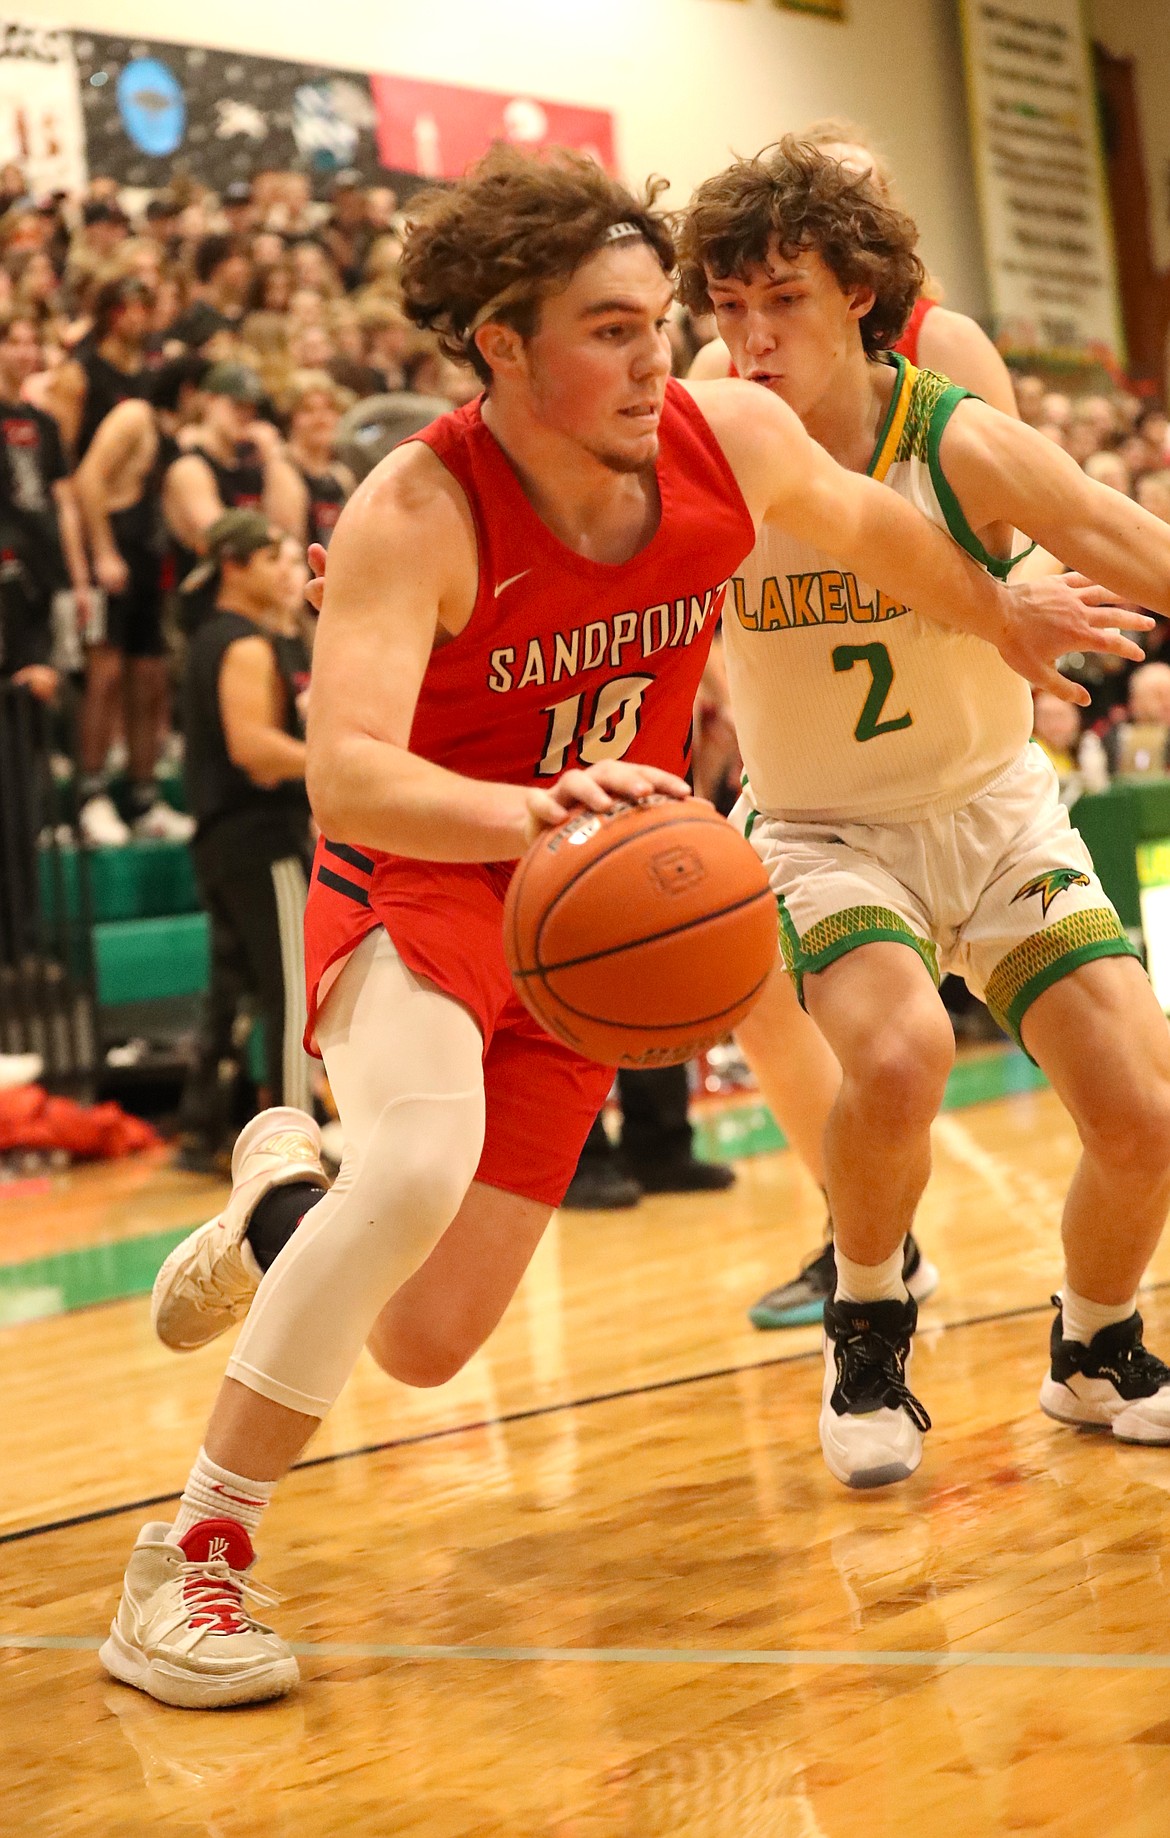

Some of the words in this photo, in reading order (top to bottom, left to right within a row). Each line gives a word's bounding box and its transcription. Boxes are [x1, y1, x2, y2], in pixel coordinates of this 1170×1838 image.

[731, 569, 912, 632] LAKELA
[533, 671, 657, 778] 10
[832, 642, 913, 742] 2
